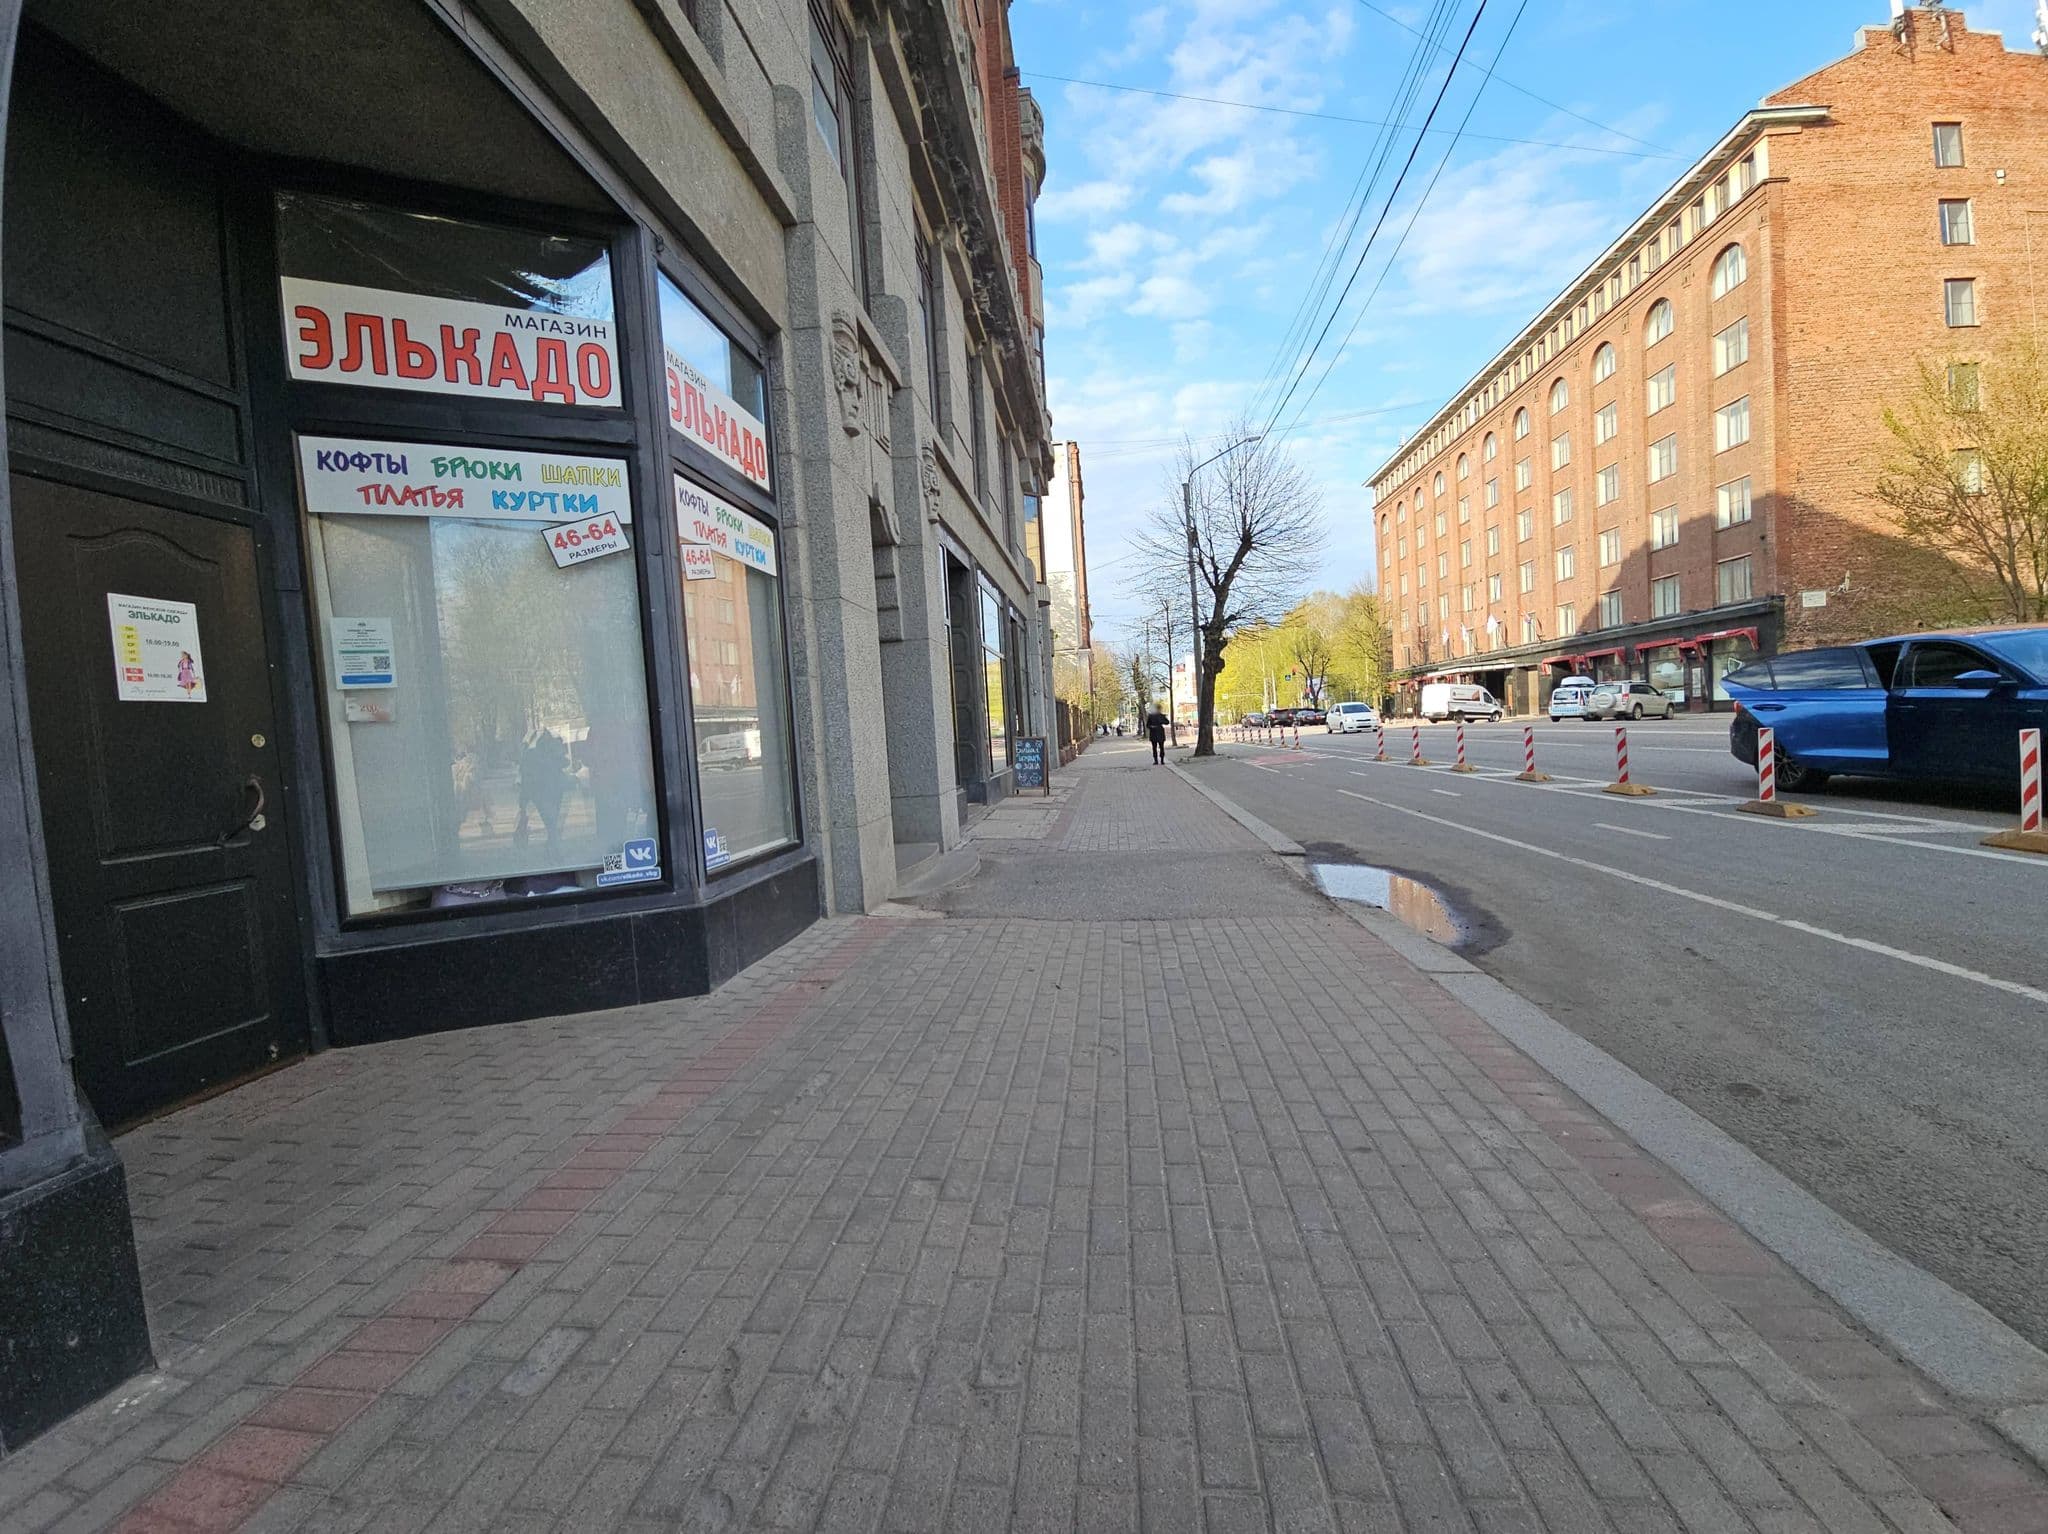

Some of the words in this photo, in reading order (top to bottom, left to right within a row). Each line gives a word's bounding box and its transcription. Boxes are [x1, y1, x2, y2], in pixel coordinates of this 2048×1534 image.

[505, 313, 607, 339] МАГАЗИН
[294, 305, 612, 405] ЭЛЬКАДО
[666, 350, 707, 392] МАГАЗИН
[667, 367, 766, 481] ЭЛЬКАДО
[316, 450, 409, 475] КОФТЫ
[430, 456, 522, 481] БРЮКИ
[541, 464, 622, 488] ШАПКИ
[357, 483, 464, 509] ПЛАТЬЯ
[491, 490, 598, 514] КУРТКИ
[679, 487, 709, 516] КОФТЫ
[715, 506, 744, 534] БРЮКИ
[553, 519, 617, 550] 46-64
[569, 541, 618, 561] РАЗМЕРЫ
[693, 520, 727, 549] ПЛАТЬЯ
[735, 538, 766, 566] КУРТКИ
[686, 549, 711, 565] 46-64
[128, 610, 181, 624] ЭЛЬКАДО
